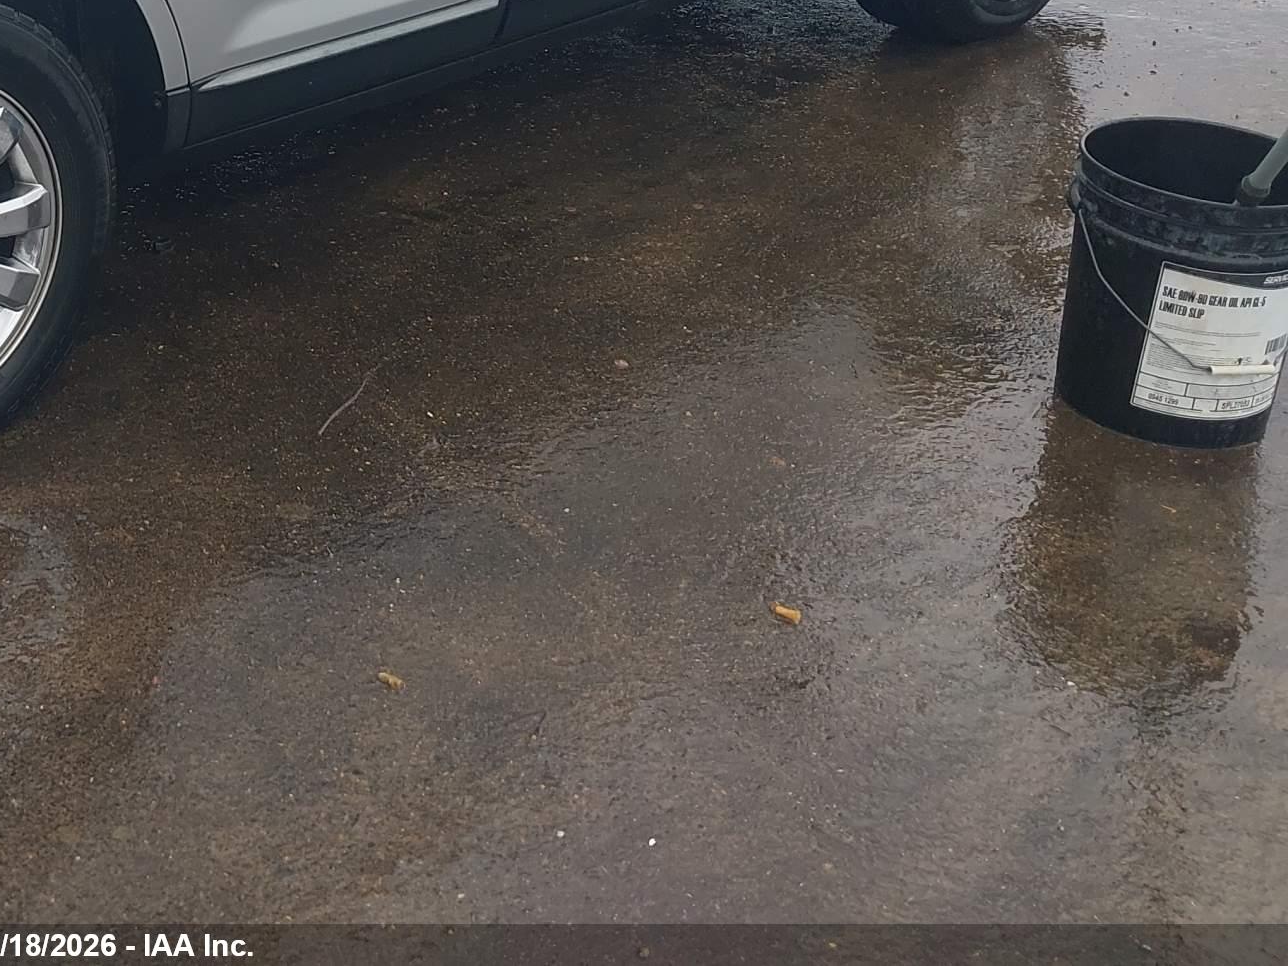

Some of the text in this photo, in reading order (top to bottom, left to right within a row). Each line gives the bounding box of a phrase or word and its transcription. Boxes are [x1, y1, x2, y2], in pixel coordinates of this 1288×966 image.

[1162, 285, 1178, 299] SAE
[1208, 295, 1227, 308] GEAR
[1228, 297, 1239, 308] OIL
[1158, 299, 1206, 319] LIMITED SLIP
